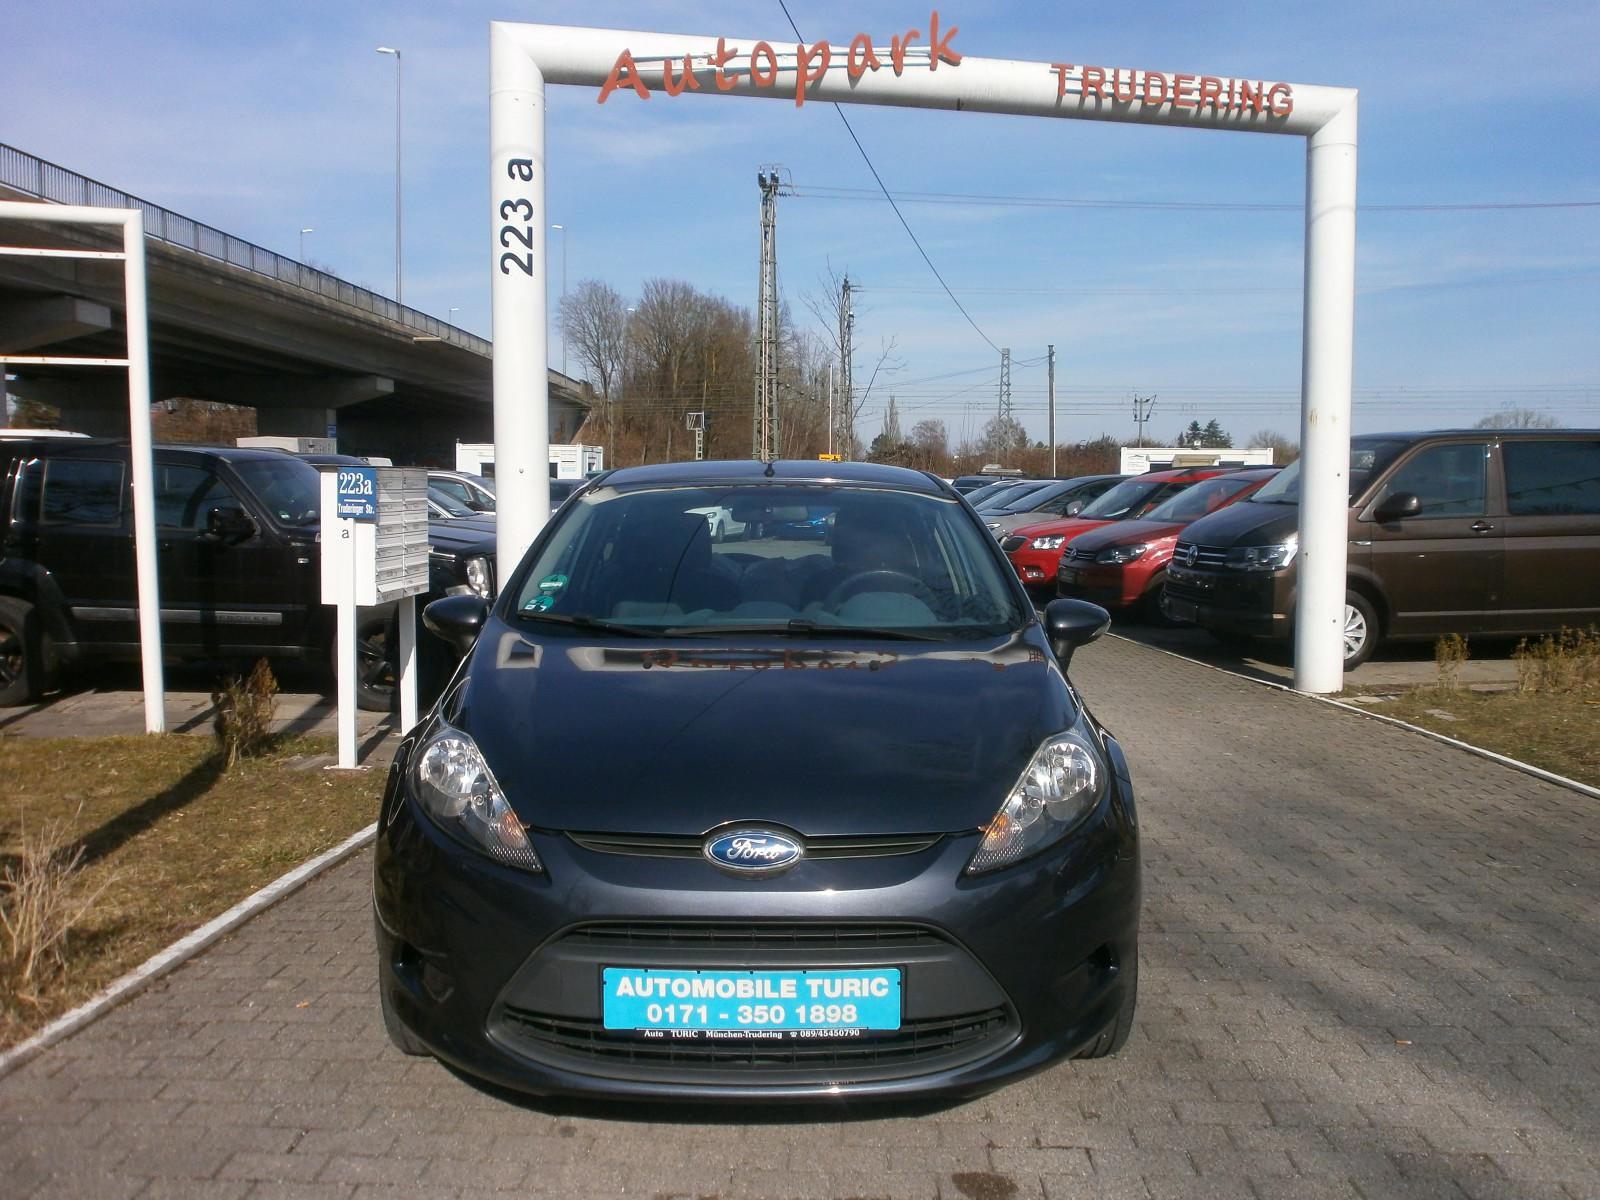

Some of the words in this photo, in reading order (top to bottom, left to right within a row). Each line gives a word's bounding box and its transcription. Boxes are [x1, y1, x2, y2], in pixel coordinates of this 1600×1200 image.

[597, 10, 962, 107] Autopark
[1050, 63, 1294, 115] TRUDERING
[507, 158, 534, 182] a
[500, 198, 534, 277] 223
[339, 472, 373, 495] 223a
[341, 528, 350, 539] a
[727, 838, 783, 859] Ford
[616, 976, 797, 998] AUTOMOBILE
[805, 976, 889, 998] TURIC
[647, 1003, 707, 1024] 0171
[737, 1004, 786, 1025] 350
[795, 1004, 858, 1024] 1898
[644, 1029, 664, 1038] Auto
[670, 1030, 699, 1038] TURIC
[705, 1030, 783, 1039] München-Trudering
[800, 1028, 860, 1038] 089/45450790
